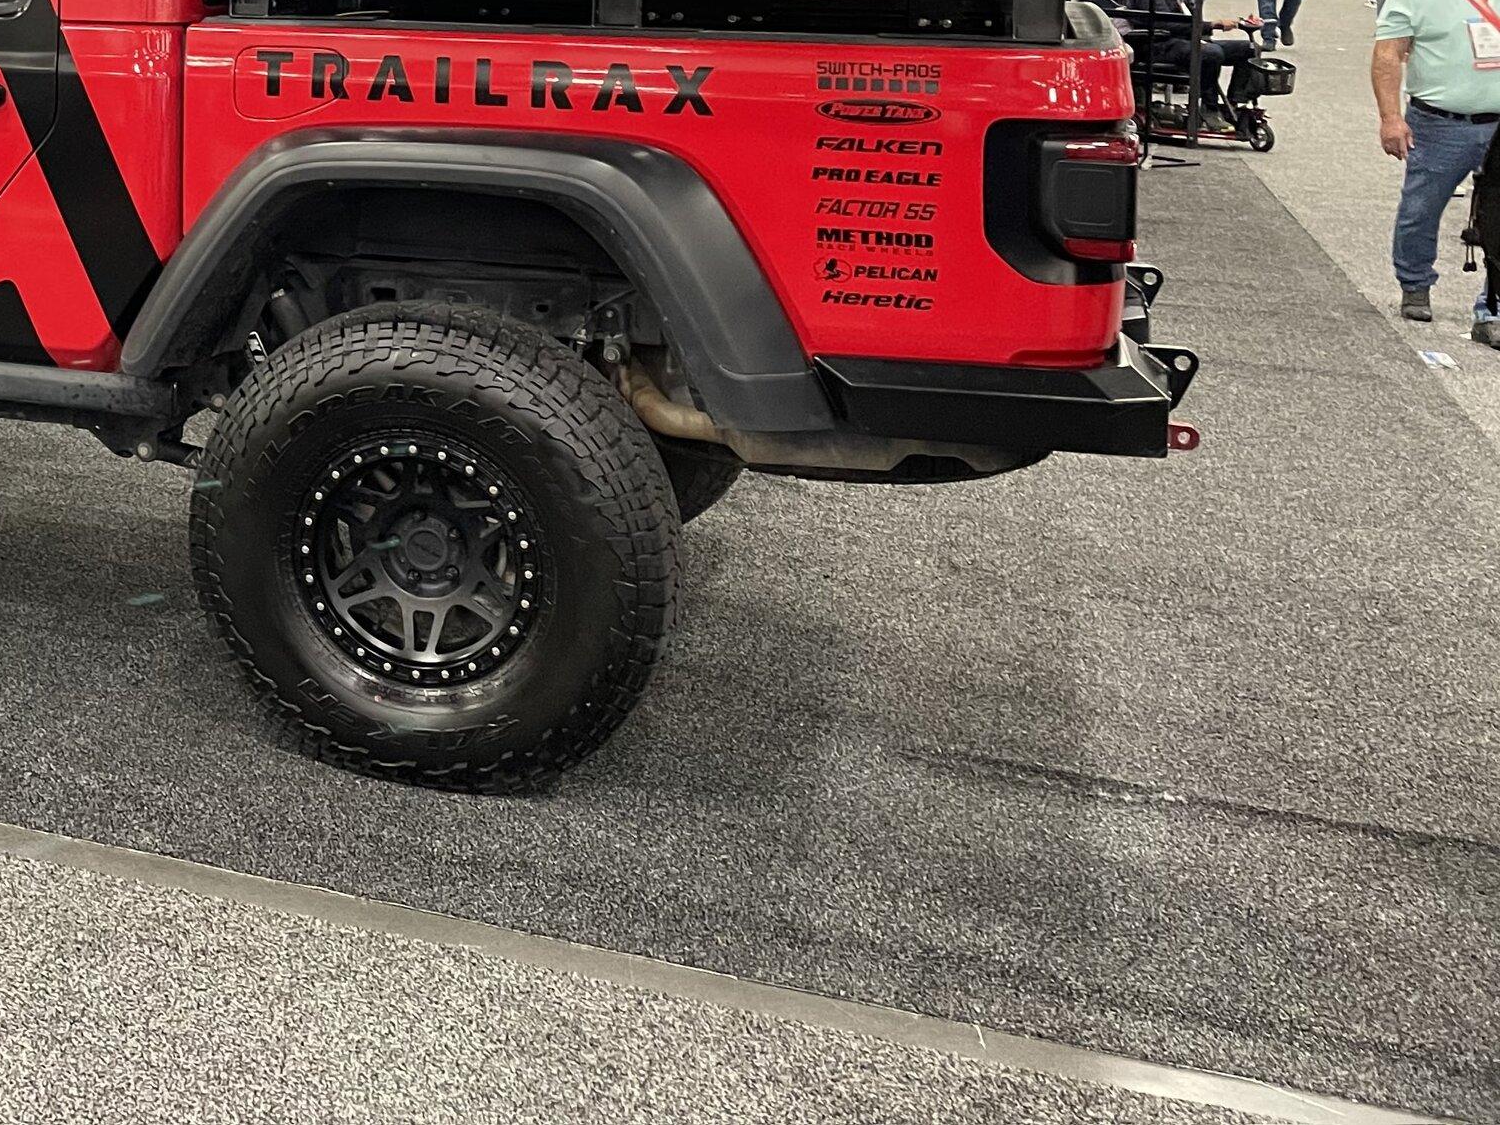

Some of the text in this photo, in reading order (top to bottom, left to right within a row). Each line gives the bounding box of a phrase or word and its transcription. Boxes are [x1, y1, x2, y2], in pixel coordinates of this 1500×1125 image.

[816, 61, 942, 78] SWITCH-PROS
[256, 49, 715, 117] TRAILRAX
[816, 137, 943, 155] FALKEN
[812, 167, 942, 187] PRO EAGLE
[815, 197, 901, 218] FACTOR
[817, 227, 934, 248] METHOD
[854, 265, 938, 282] PELICAN
[821, 290, 934, 310] Heretic
